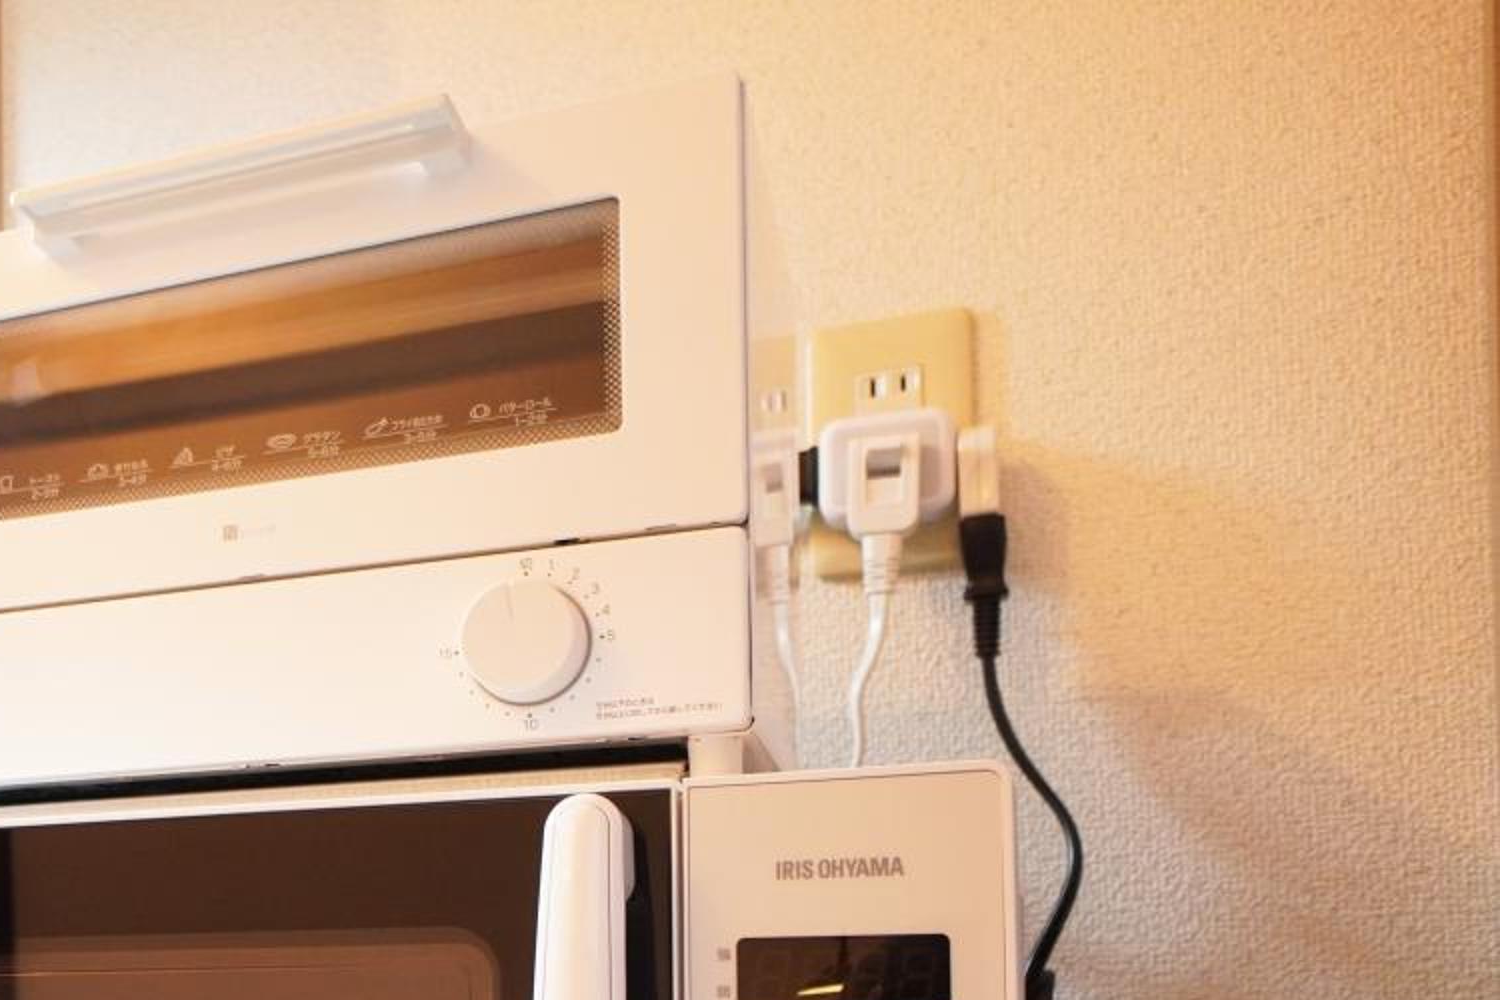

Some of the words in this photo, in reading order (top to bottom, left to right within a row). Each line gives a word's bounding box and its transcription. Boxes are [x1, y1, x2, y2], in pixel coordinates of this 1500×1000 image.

[524, 719, 539, 731] 10
[775, 861, 813, 881] IRIS
[818, 857, 904, 879] OHYAMA
